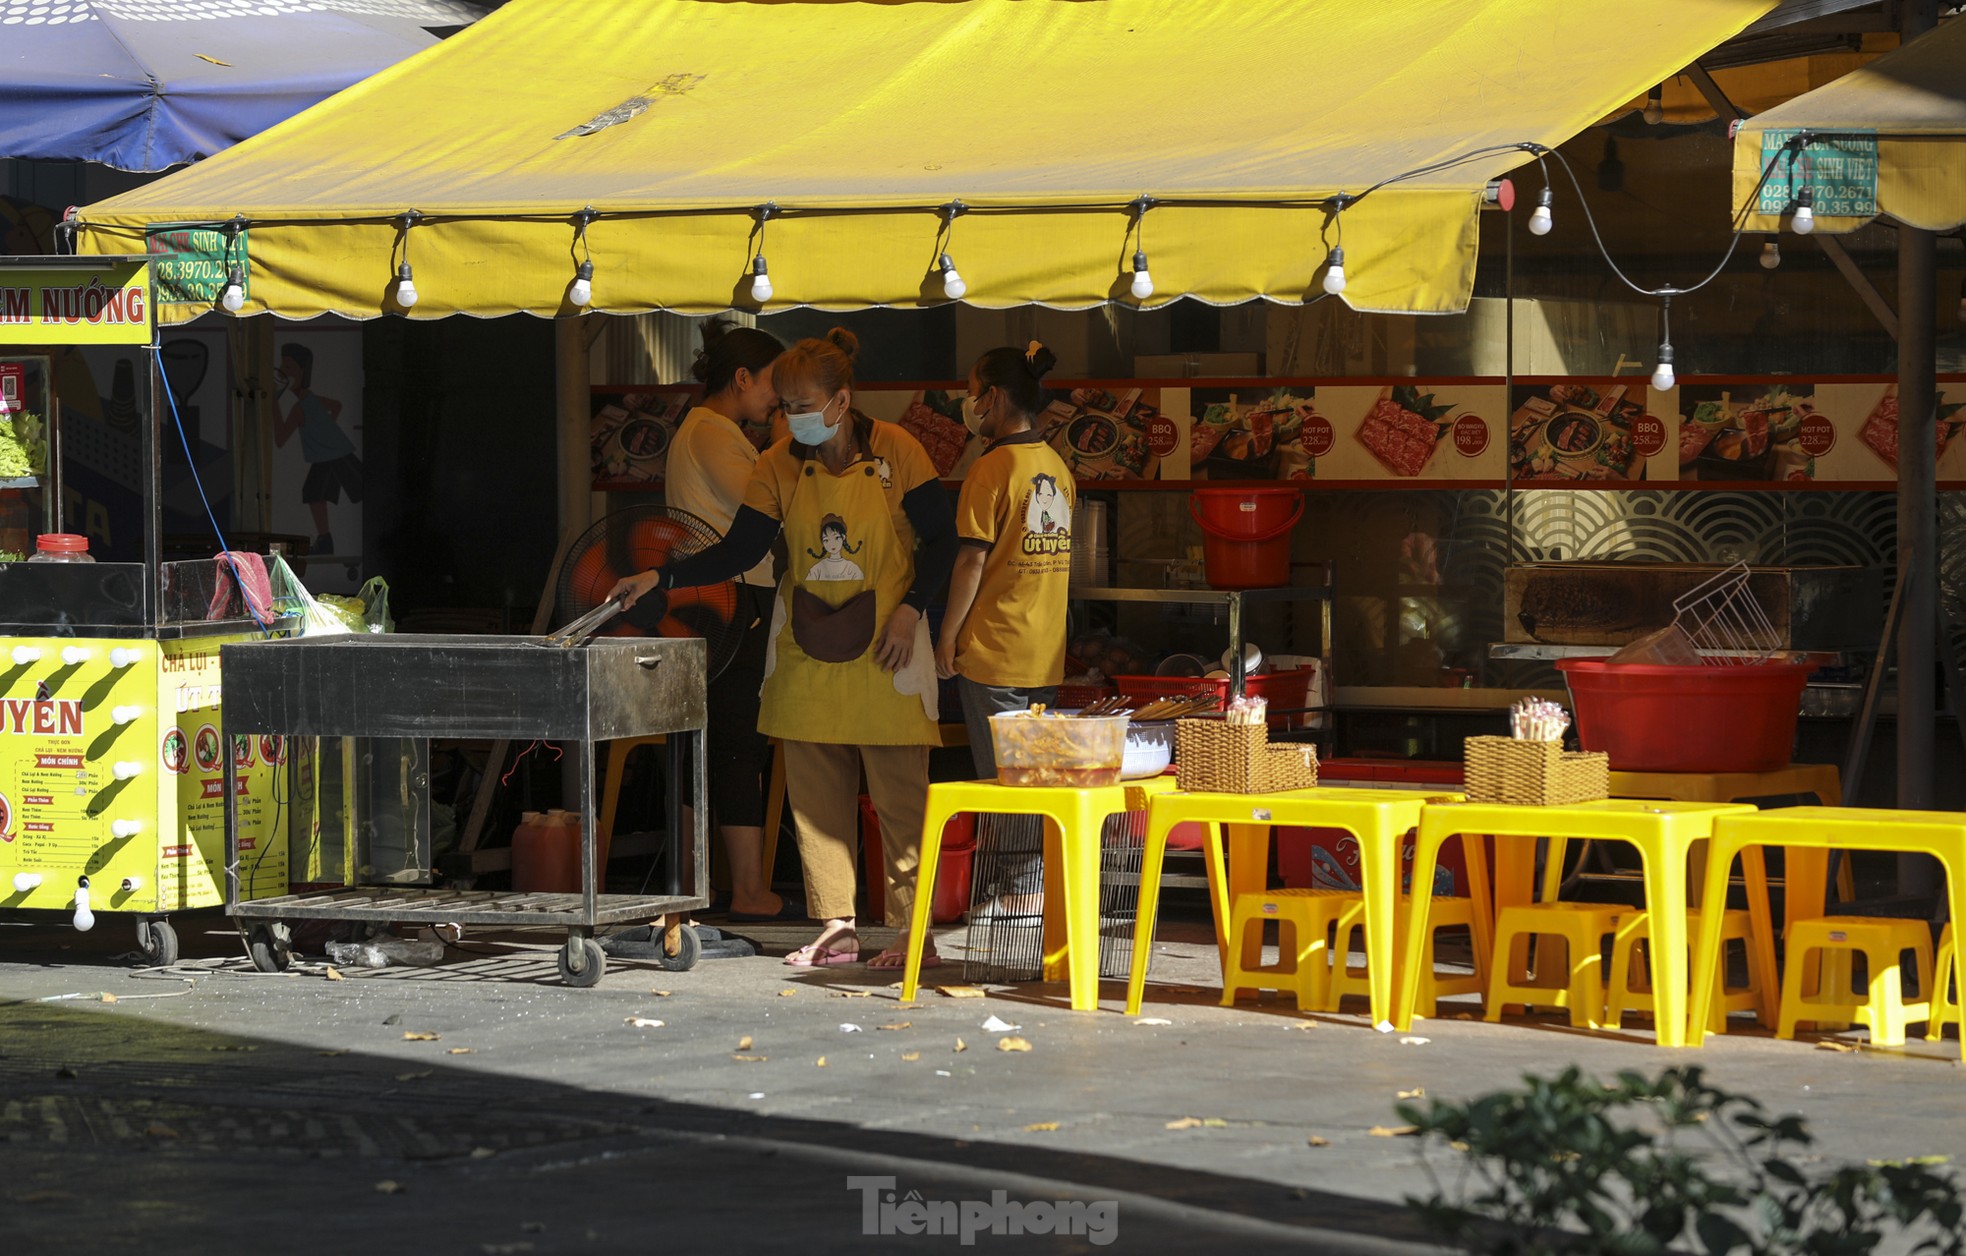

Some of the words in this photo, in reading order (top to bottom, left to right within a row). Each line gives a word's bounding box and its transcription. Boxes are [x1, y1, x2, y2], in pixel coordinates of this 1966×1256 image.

[1817, 157, 1844, 180] SINH
[1763, 184, 1873, 200] 028.70.2671
[193, 231, 218, 252] SINH
[41, 275, 145, 325] NƯỚNG
[1152, 424, 1171, 435] BBQ
[1302, 426, 1316, 434] HOT
[1316, 426, 1330, 434] POT
[1637, 422, 1659, 434] BBQ
[1801, 425, 1816, 434] HOT
[1816, 425, 1830, 434] POT
[1024, 533, 1041, 552] Út
[162, 647, 185, 673] CHẢ
[190, 652, 206, 676] LỤI
[0, 682, 82, 734] YỀN
[41, 756, 56, 766] MÓN
[57, 756, 79, 767] CHÍNH
[207, 782, 222, 793] MÓN
